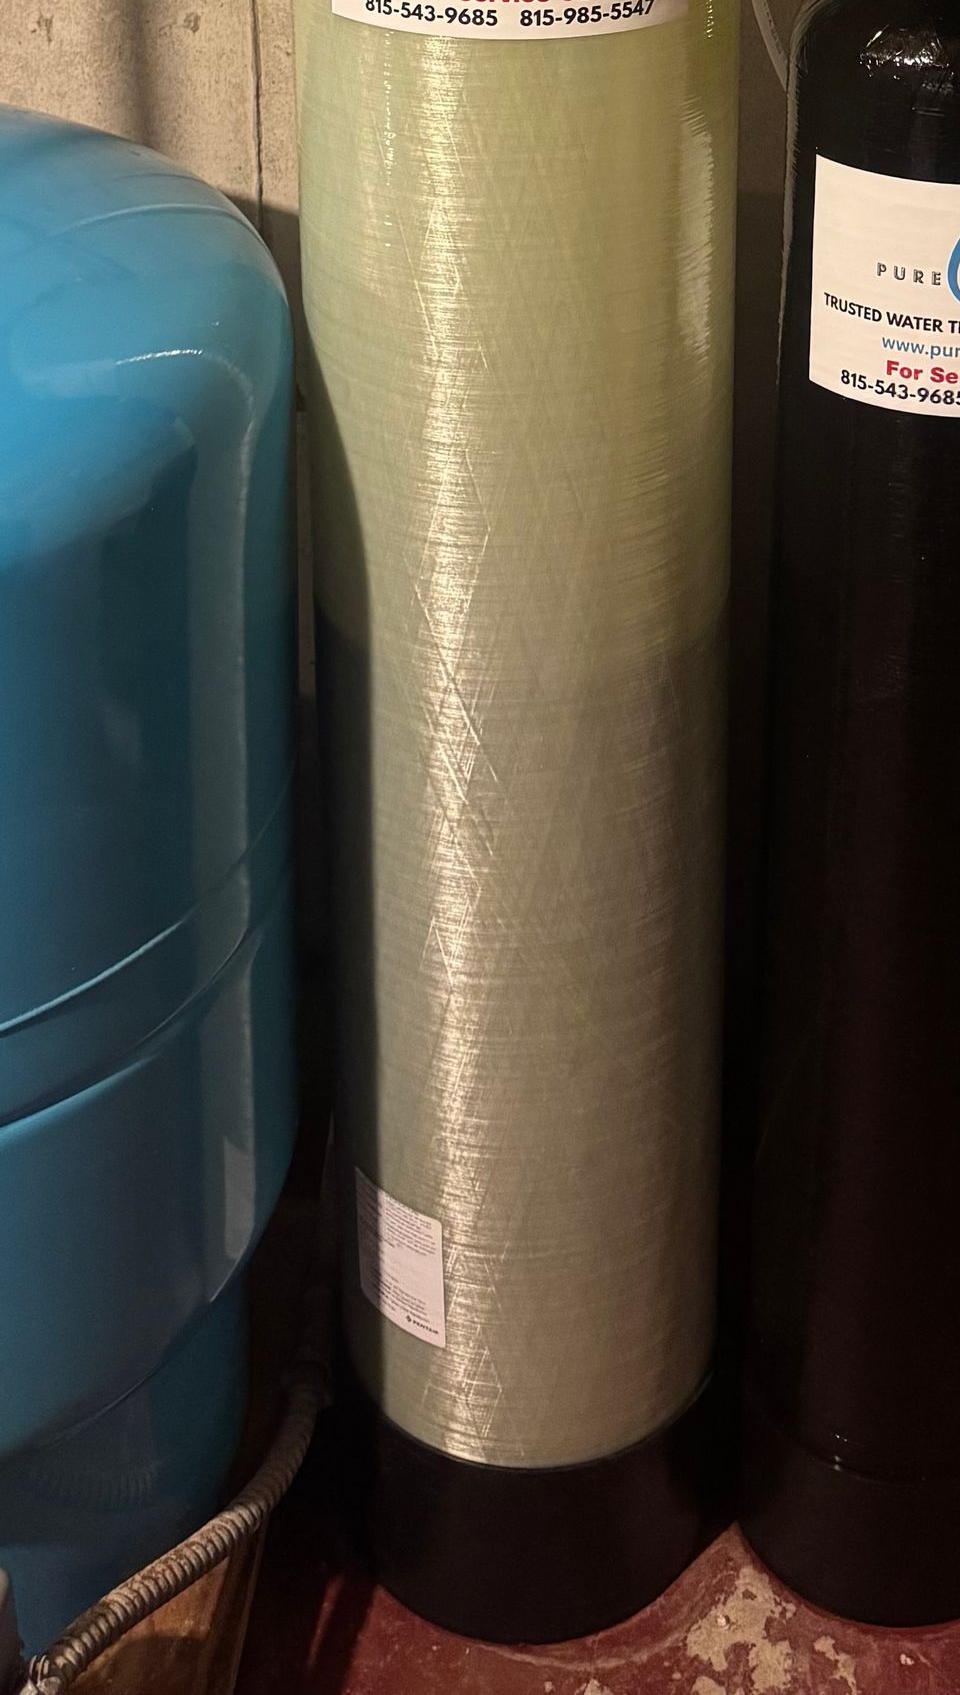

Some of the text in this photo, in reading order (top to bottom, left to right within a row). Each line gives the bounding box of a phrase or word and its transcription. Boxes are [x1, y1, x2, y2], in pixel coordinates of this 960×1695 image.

[876, 261, 942, 286] PURE
[823, 292, 882, 323] TRUSTED
[886, 311, 944, 333] WATER
[886, 360, 923, 381] For
